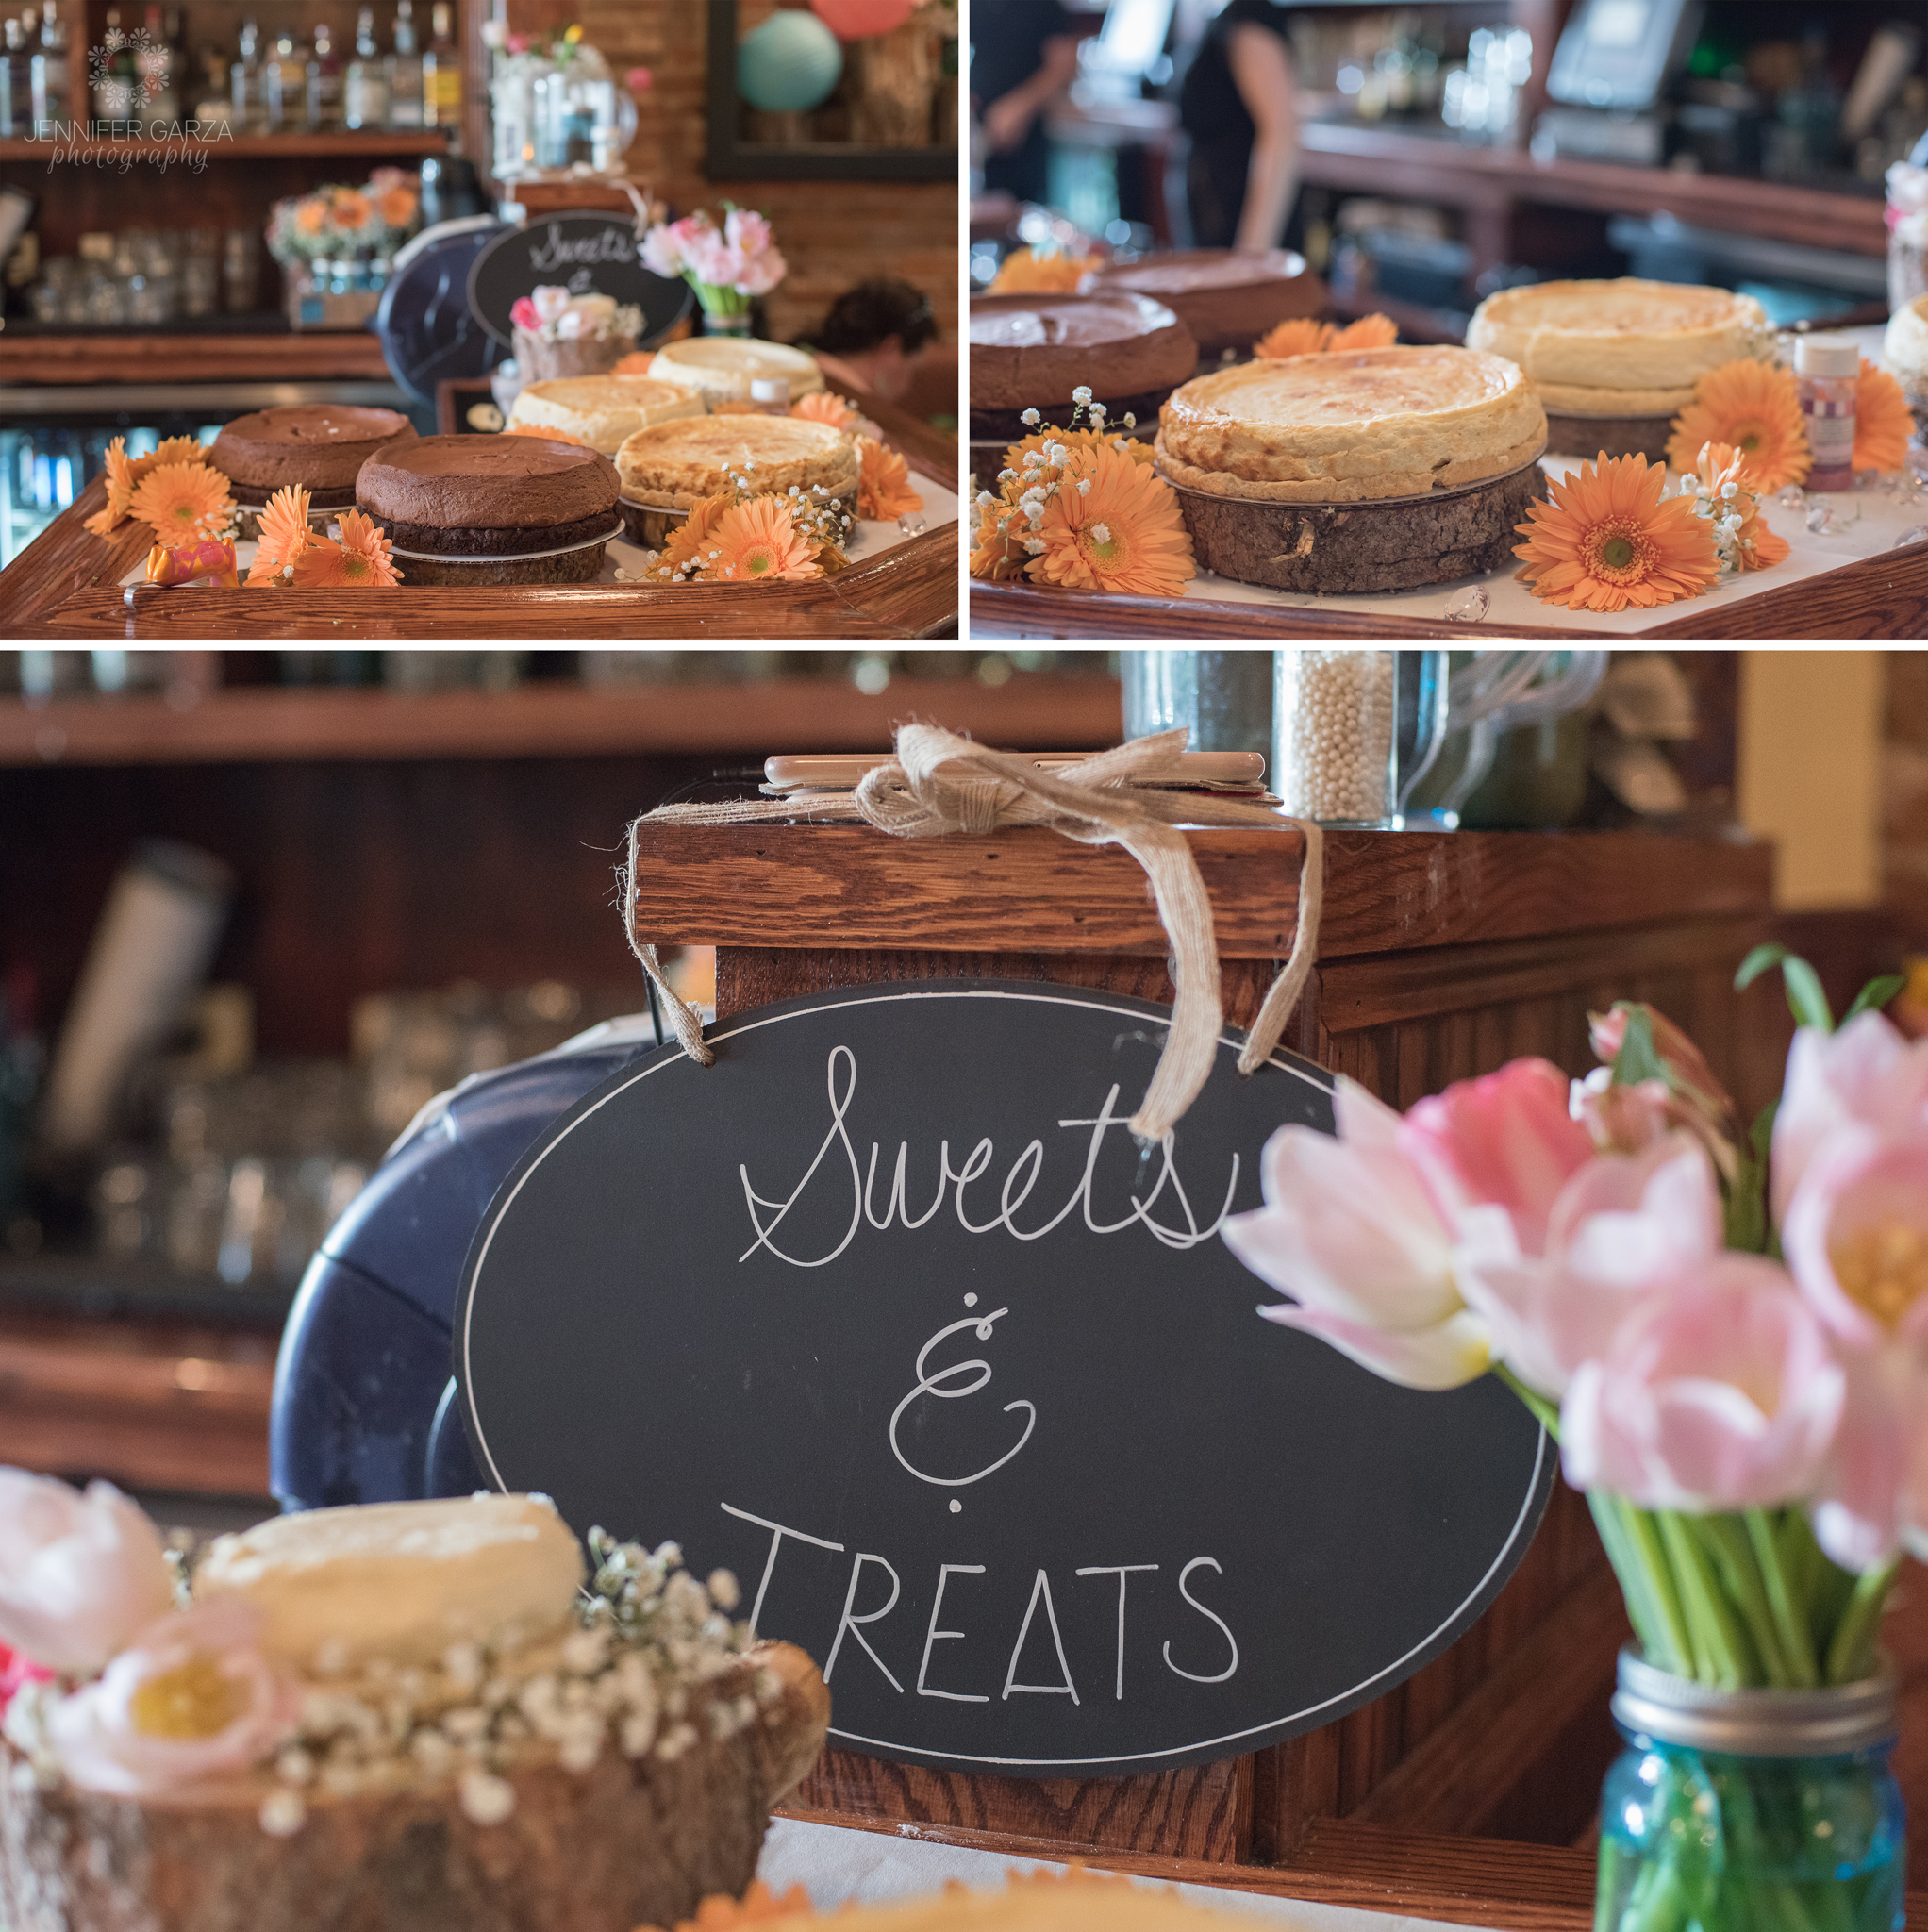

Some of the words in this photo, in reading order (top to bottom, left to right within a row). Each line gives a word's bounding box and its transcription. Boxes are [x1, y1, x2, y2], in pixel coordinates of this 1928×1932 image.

[739, 1044, 1240, 1267] Sweets
[889, 1292, 1037, 1513] &
[720, 1501, 1239, 1706] TREATS
